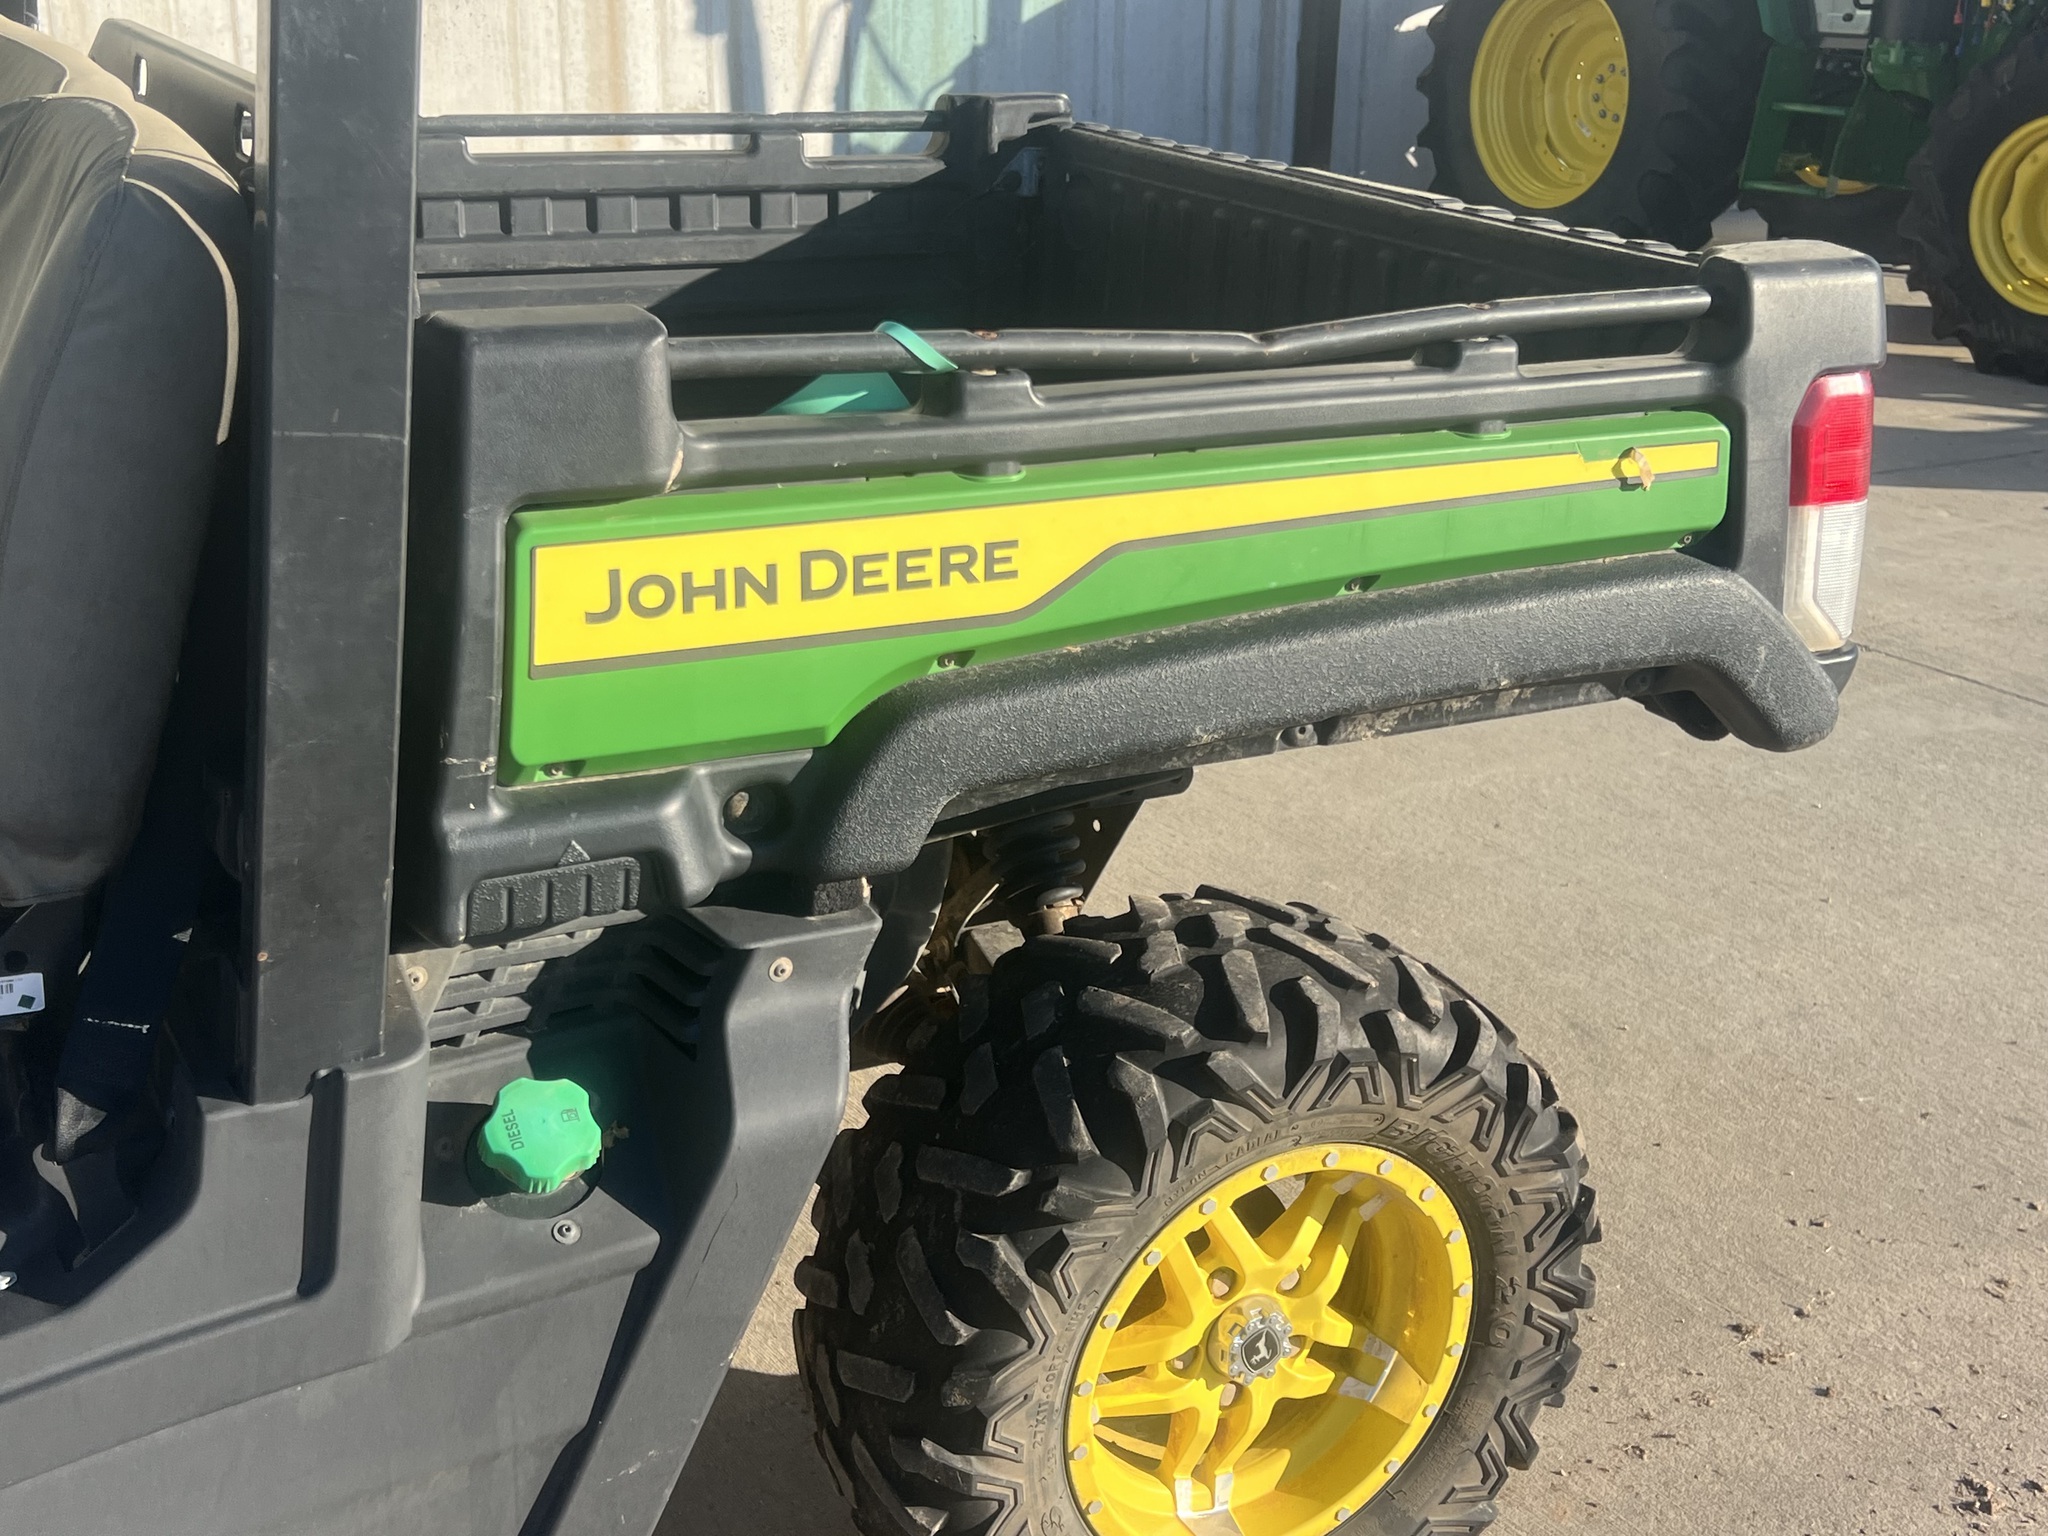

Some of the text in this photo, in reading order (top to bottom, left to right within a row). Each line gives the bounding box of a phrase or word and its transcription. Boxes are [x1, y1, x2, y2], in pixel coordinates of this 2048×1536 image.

[584, 539, 1019, 625] JOHN DEERE
[502, 1108, 525, 1151] DIESEL
[1378, 1117, 1521, 1348] BIGHORN 2.0
